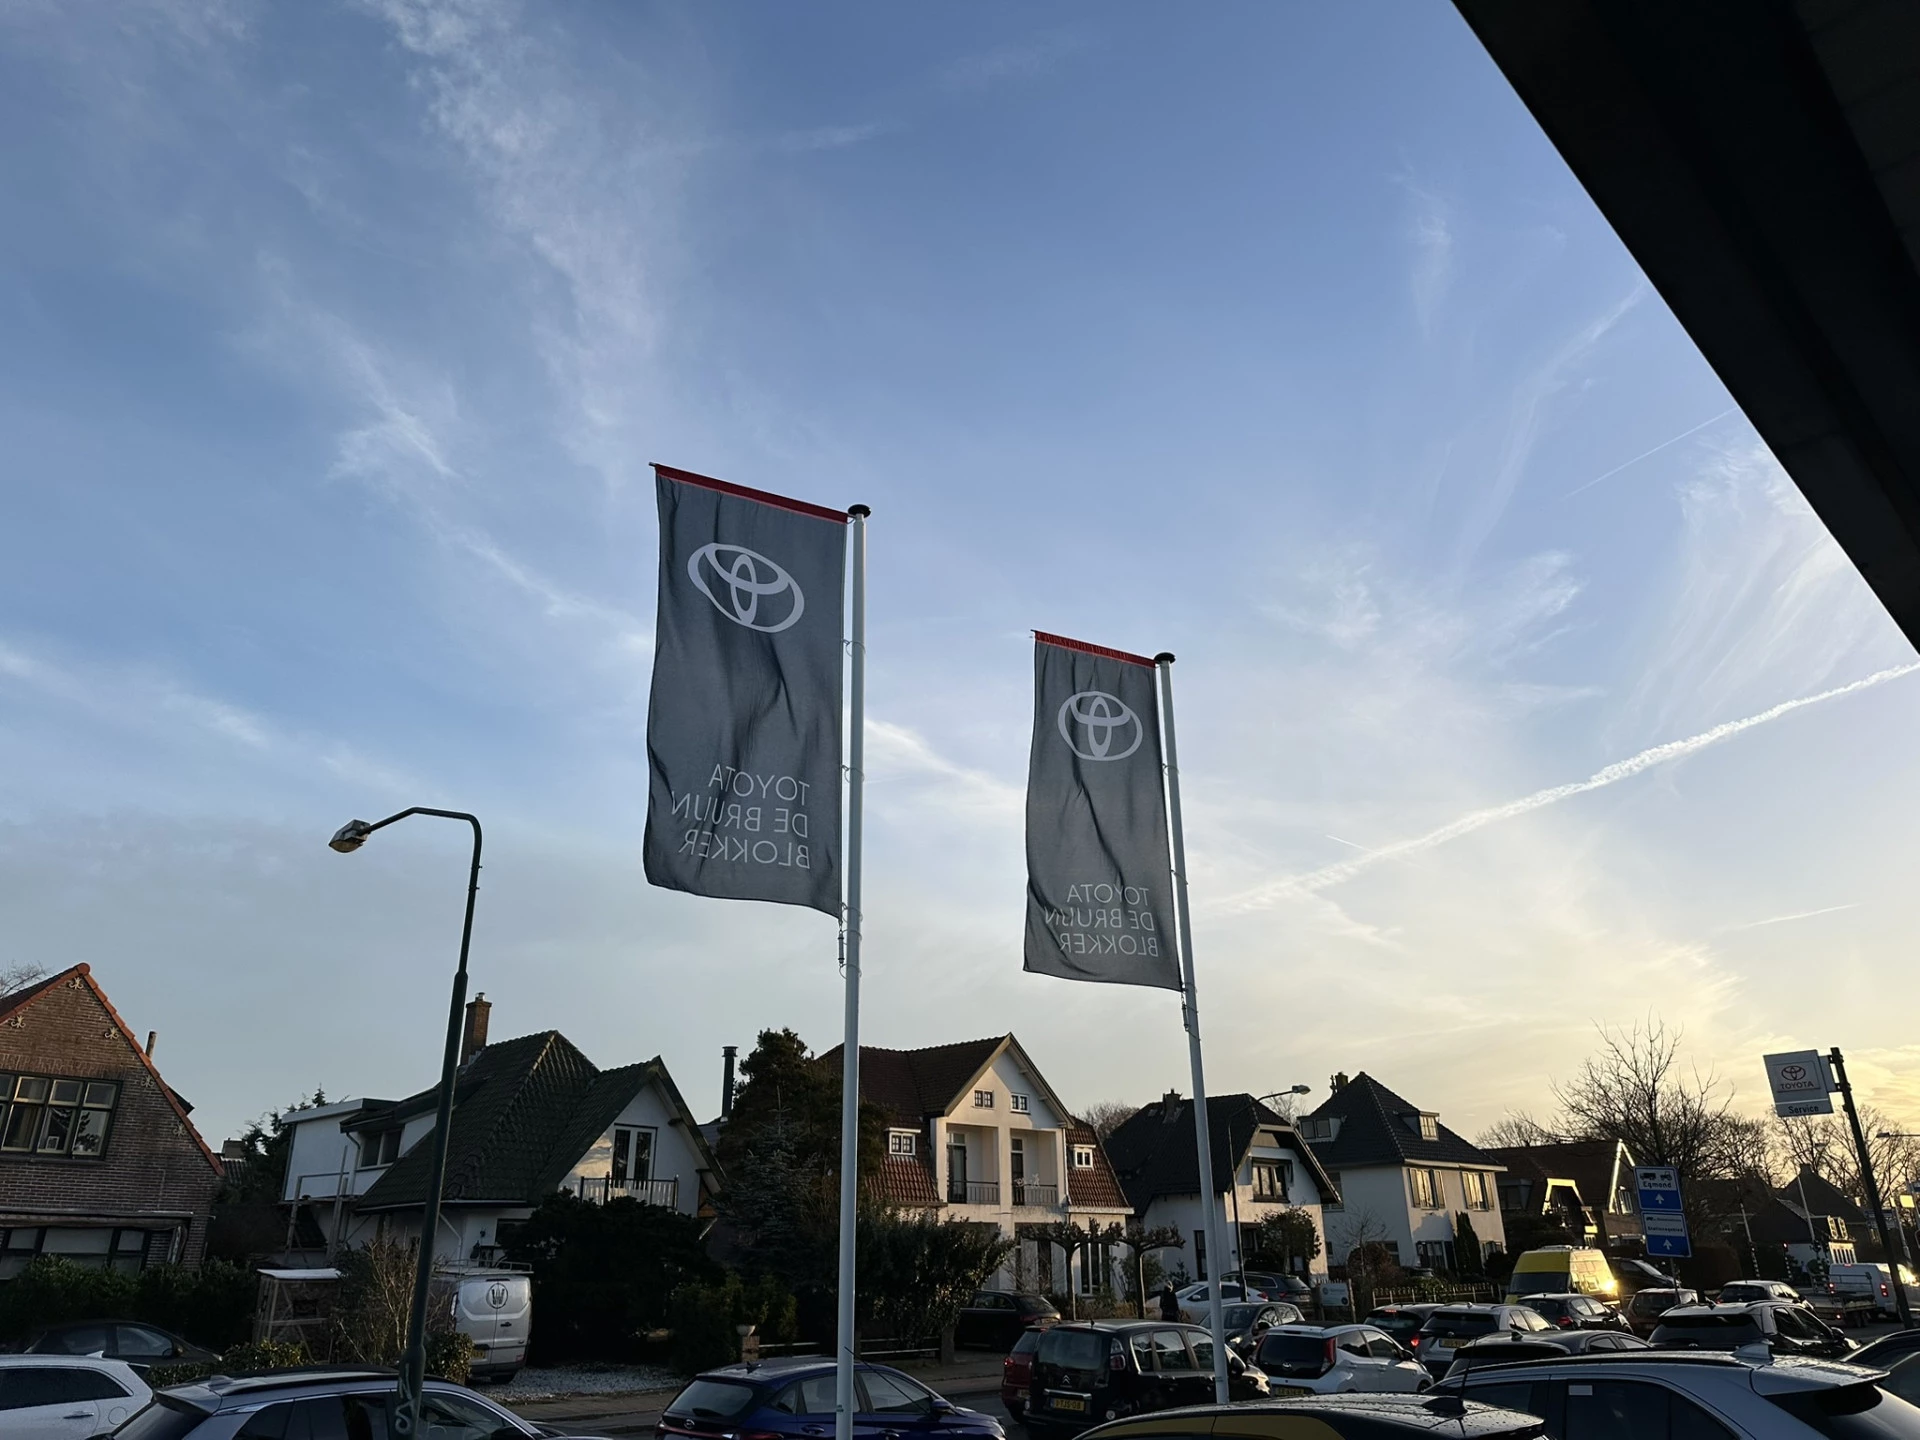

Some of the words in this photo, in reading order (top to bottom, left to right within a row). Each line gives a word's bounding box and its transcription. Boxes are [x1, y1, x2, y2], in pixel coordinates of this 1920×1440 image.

[1780, 1081, 1814, 1090] TOYOTA
[1788, 1104, 1819, 1114] Service
[1643, 1181, 1672, 1189] Egmond
